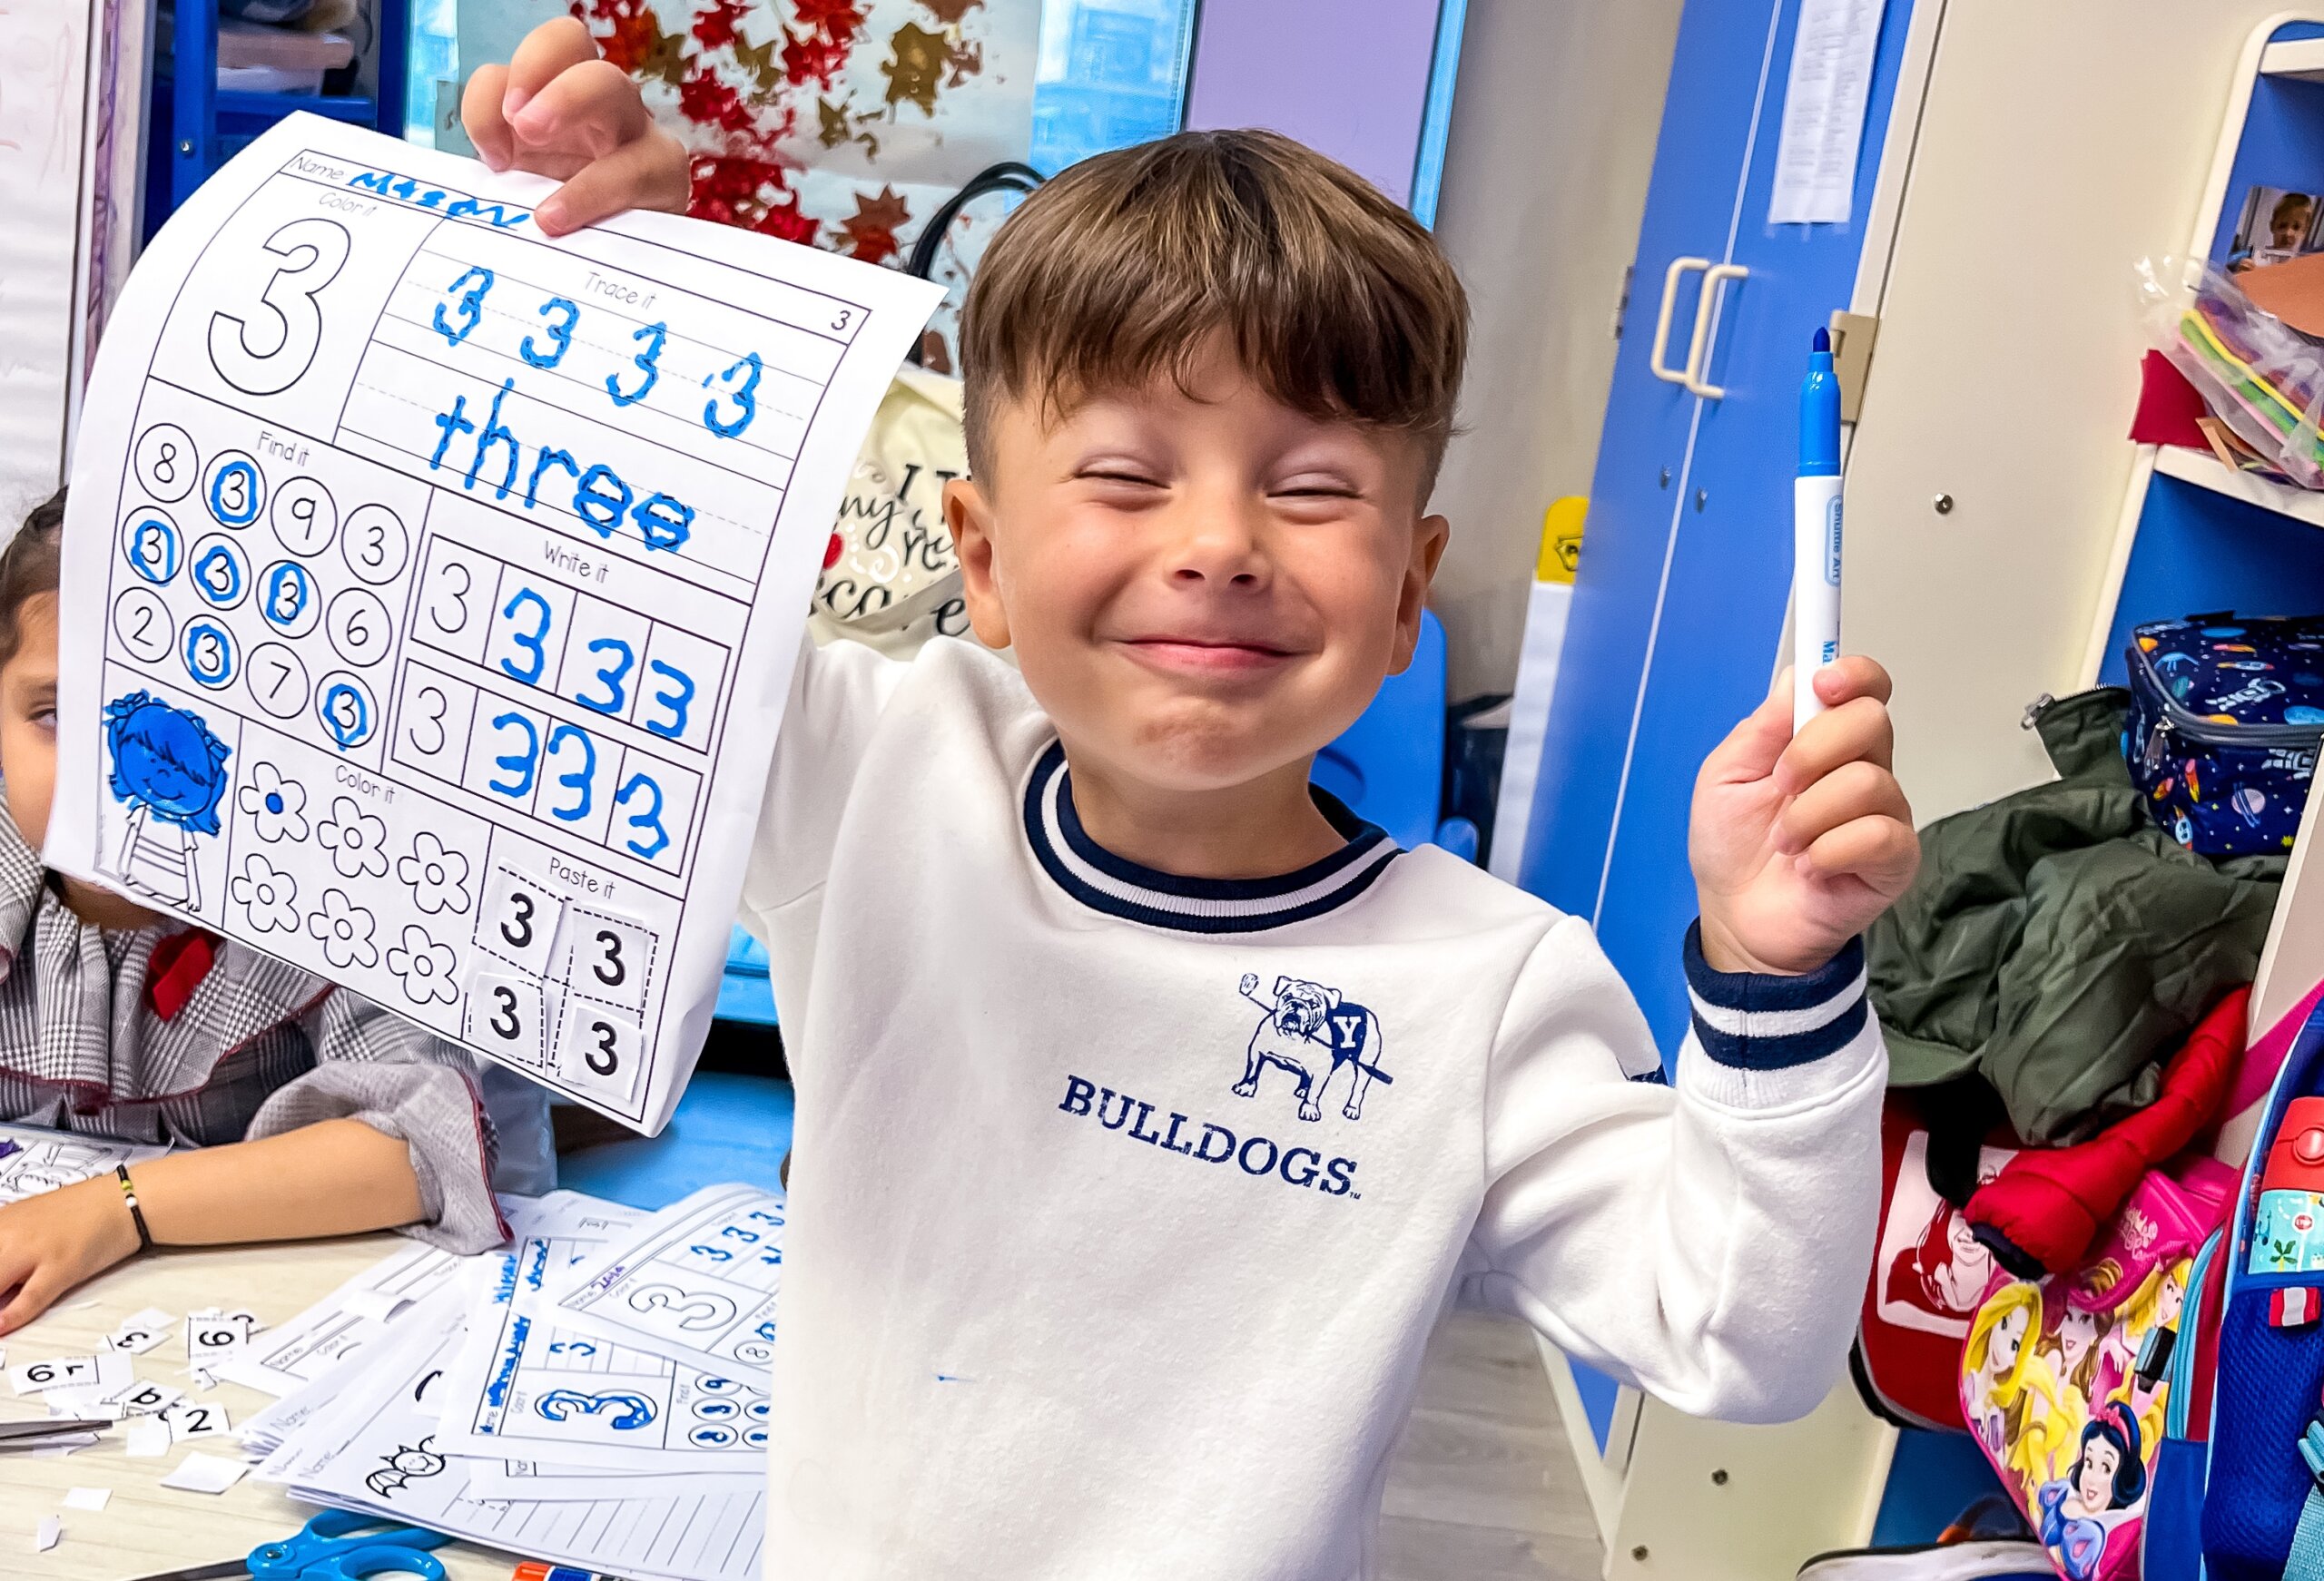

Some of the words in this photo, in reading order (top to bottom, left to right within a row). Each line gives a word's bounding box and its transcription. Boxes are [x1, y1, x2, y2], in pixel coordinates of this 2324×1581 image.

[319, 191, 363, 213] Color
[208, 217, 351, 397] 3
[584, 271, 638, 305] Trace
[642, 292, 657, 310] it
[831, 309, 851, 330] 3
[520, 297, 580, 368] 3
[703, 351, 763, 438] 3
[256, 430, 298, 463] Find
[296, 447, 310, 466] it
[429, 377, 694, 552] three
[153, 443, 177, 484] 8
[222, 470, 245, 510] 3
[291, 497, 317, 540] 9
[360, 526, 385, 566] 3
[140, 525, 162, 565] 3
[206, 552, 230, 592] 3
[277, 582, 300, 621] 3
[346, 609, 369, 646] 6
[431, 562, 471, 633] 3
[545, 540, 591, 577] Write
[596, 563, 610, 584] it
[132, 606, 154, 647] 2
[198, 633, 220, 673] 3
[269, 661, 291, 699] 7
[332, 690, 356, 729] 3
[501, 587, 552, 685] 3
[576, 638, 635, 714] 3
[646, 659, 695, 738] 3
[409, 686, 448, 755] 3
[335, 764, 382, 798] Color
[384, 788, 396, 805] it
[489, 712, 539, 799] 3
[547, 725, 596, 821] 3
[615, 772, 670, 860] 3
[549, 857, 599, 894] Paste
[603, 880, 617, 900] it
[499, 892, 535, 948] 3
[592, 930, 626, 987] 3
[489, 986, 521, 1041] 3
[584, 1021, 619, 1077] 3
[1333, 1016, 1362, 1049] Y
[1059, 1075, 1357, 1196] BULLDOGS
[185, 1409, 212, 1433] 2
